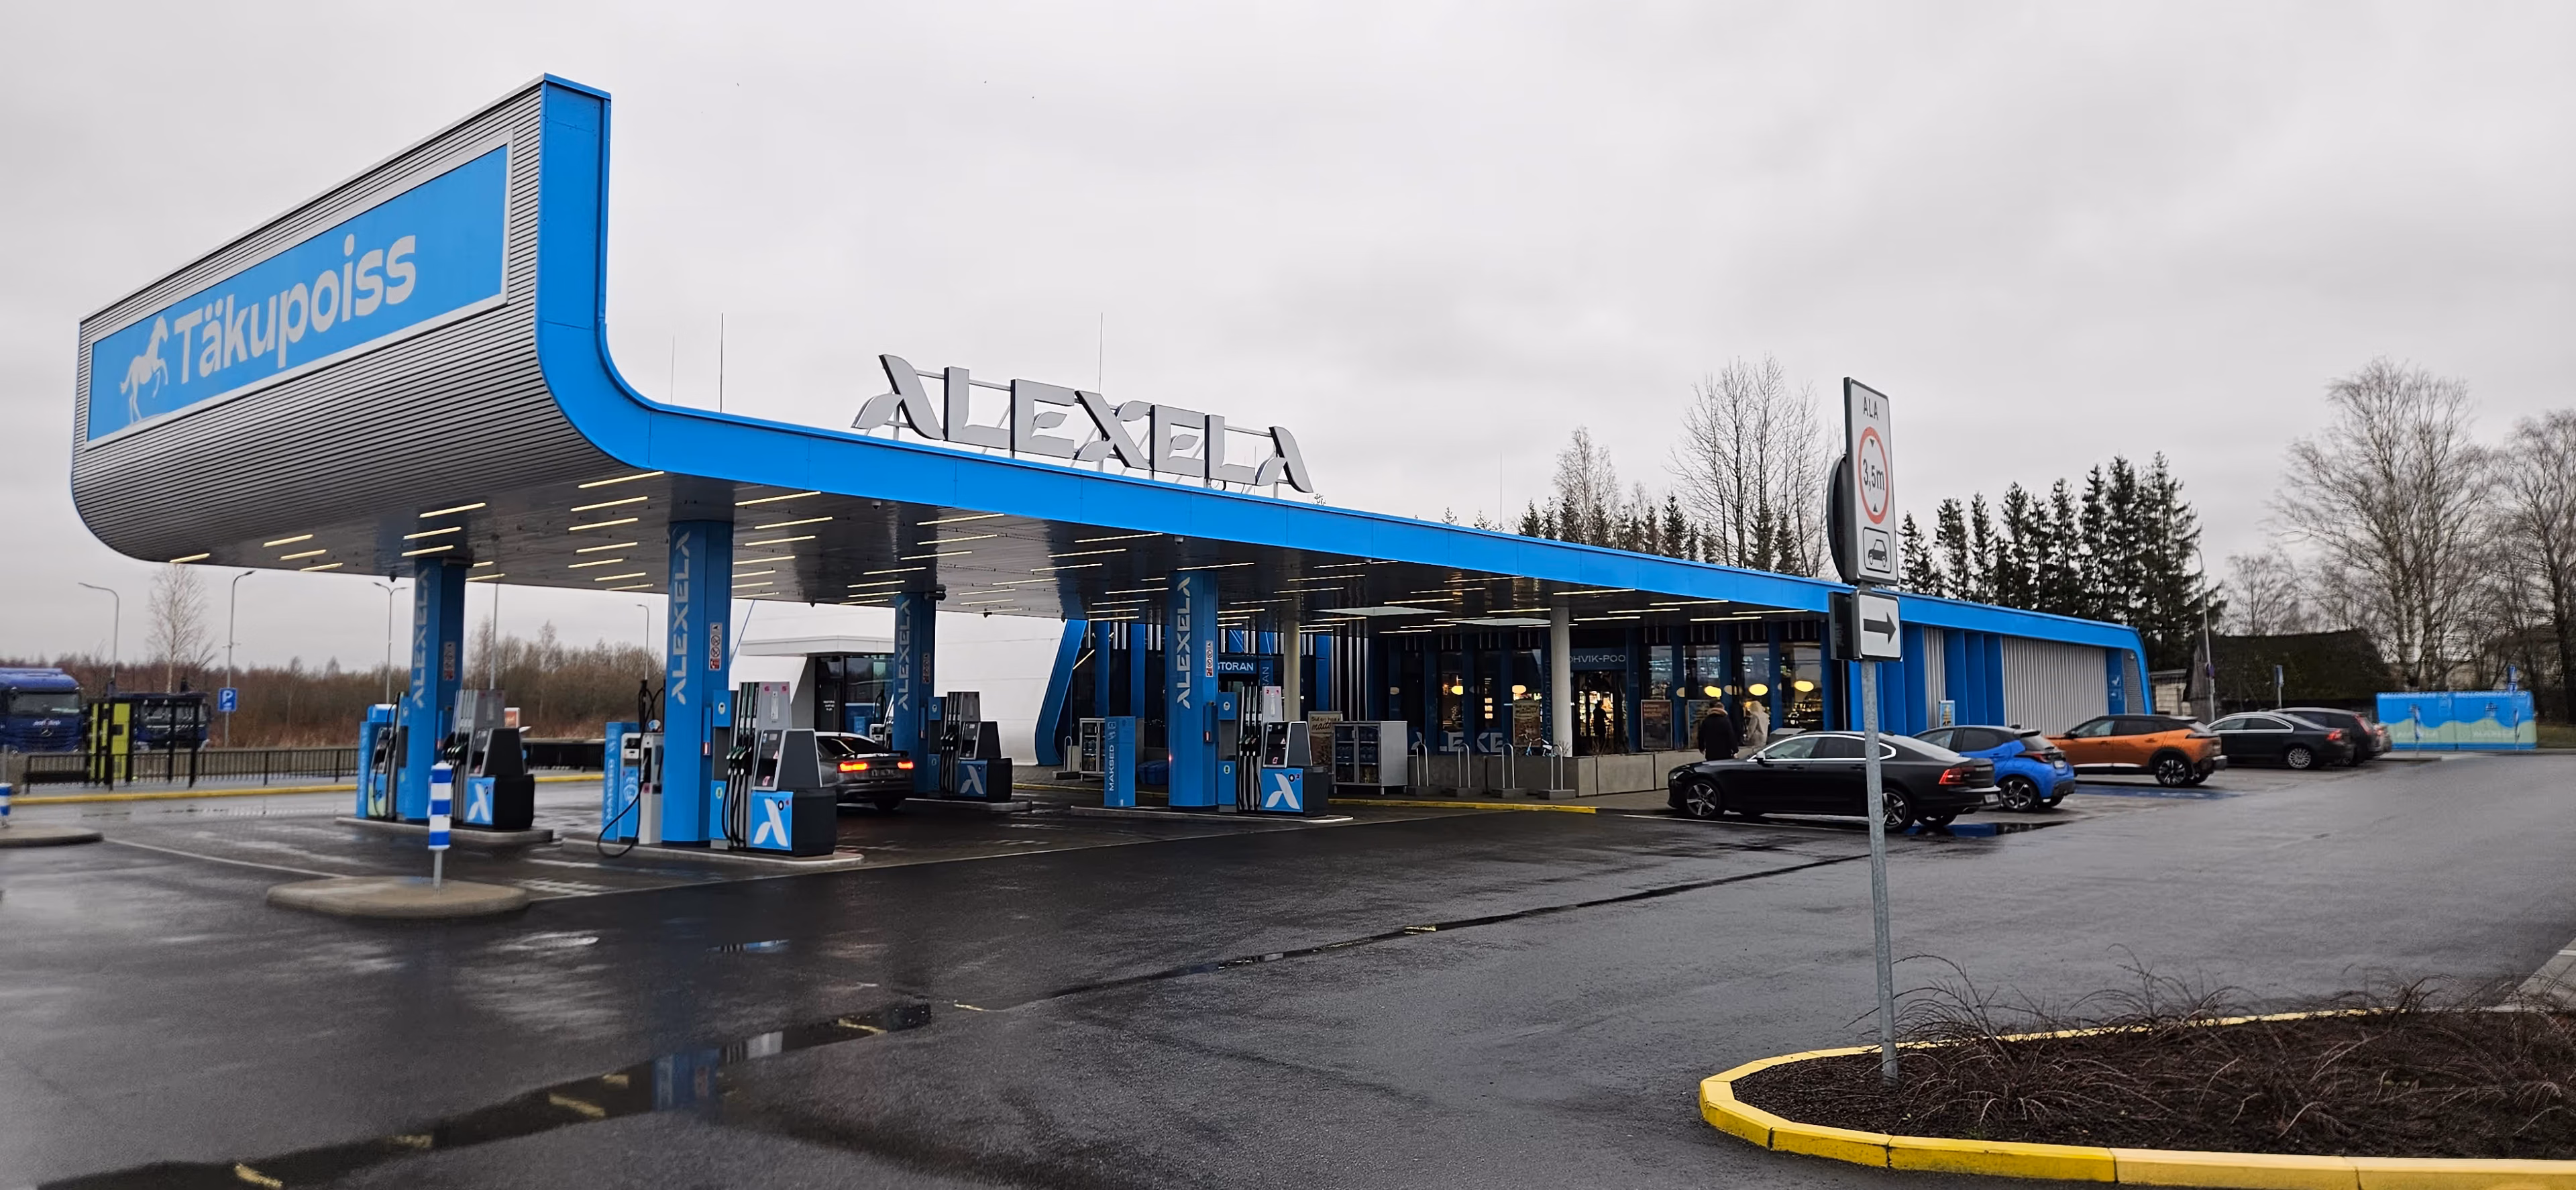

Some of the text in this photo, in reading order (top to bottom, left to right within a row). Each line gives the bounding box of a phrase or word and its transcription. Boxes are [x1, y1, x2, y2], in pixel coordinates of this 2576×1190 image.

[174, 233, 416, 385] Täkupoiss
[851, 354, 1313, 494] ALEXELA
[1863, 396, 1879, 421] ALA
[1863, 458, 1885, 491] 3,5m
[413, 568, 429, 708] ALEXELA
[672, 531, 690, 705] ALEXELA
[898, 598, 910, 712] ALEXELA
[1177, 576, 1191, 709] ALEXELA
[223, 690, 233, 702] P
